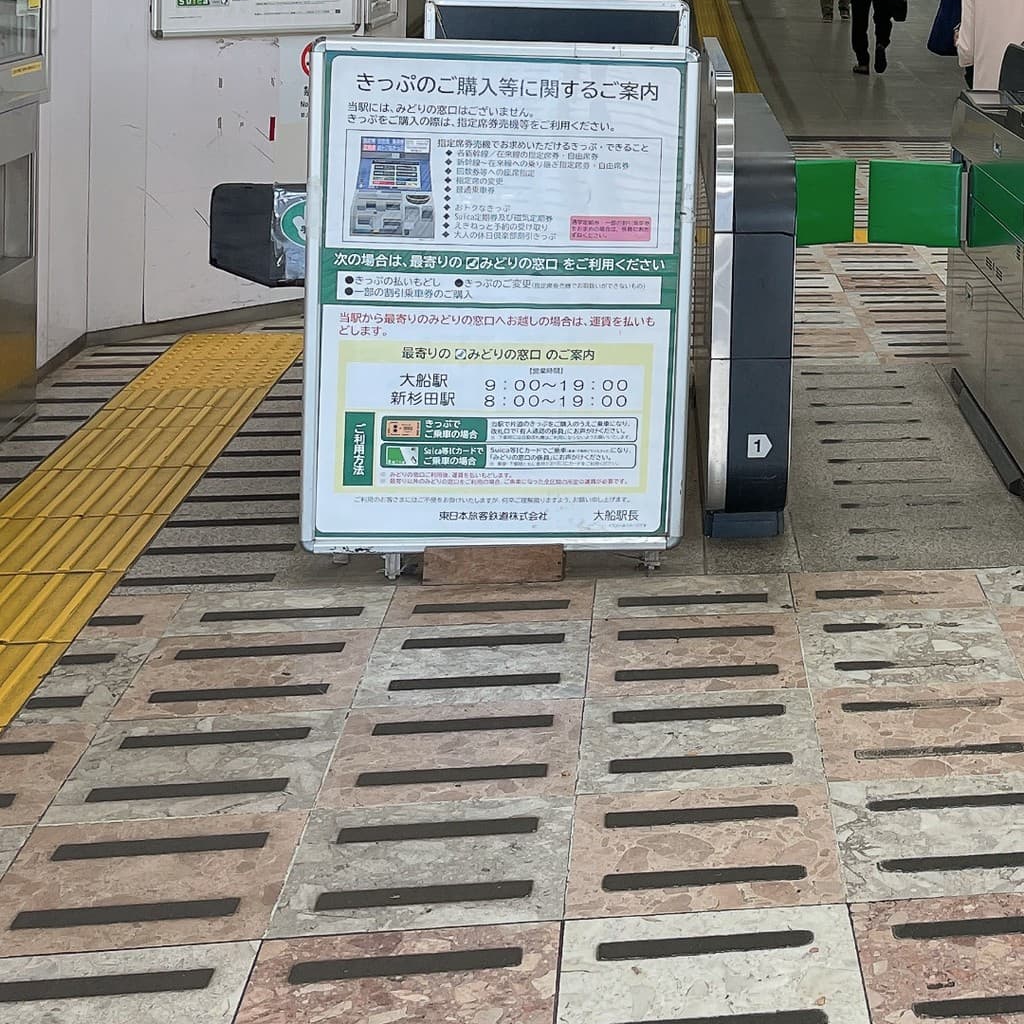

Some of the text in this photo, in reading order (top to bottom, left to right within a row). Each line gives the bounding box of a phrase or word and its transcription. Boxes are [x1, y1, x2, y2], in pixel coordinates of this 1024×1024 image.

[356, 72, 659, 102] きっぷのご購入等に関するご案内
[347, 102, 534, 118] 当駅には、みどりの窓口はございません。
[347, 114, 616, 132] きっぷをご購入の際は、指定席券売機等をご利用ください。
[437, 138, 649, 153] 指定席券売機でお求めいただけるきっぷ・できること
[456, 176, 504, 185] 指定席の変更
[454, 204, 511, 213] おトクなきっぷ
[334, 251, 665, 272] 次の場合は、最寄りの みどりの窓口 をご利用ください
[354, 275, 441, 288] きっぷの払いもどし
[464, 277, 532, 290] きっぷのご変更
[354, 286, 473, 300] 一部の割引乗車券のご購入
[338, 311, 656, 328] 当駅から最寄りのみどりの窓口へお越しの場合は、運賃を払いも
[338, 325, 389, 337] どします。
[402, 346, 595, 362] 最寄りの みどりの窓口 のご案内
[400, 373, 448, 388] 大船駅
[390, 391, 456, 406] 新杉田駅
[425, 419, 461, 429] きっぷで
[424, 430, 478, 440] ご乗車の場合
[353, 423, 367, 476] ご利用方法
[753, 440, 760, 452] 1
[423, 457, 477, 466] ご乗車の場合
[439, 510, 640, 522] 東日本旅客鉄道株式会社 大船駅長
